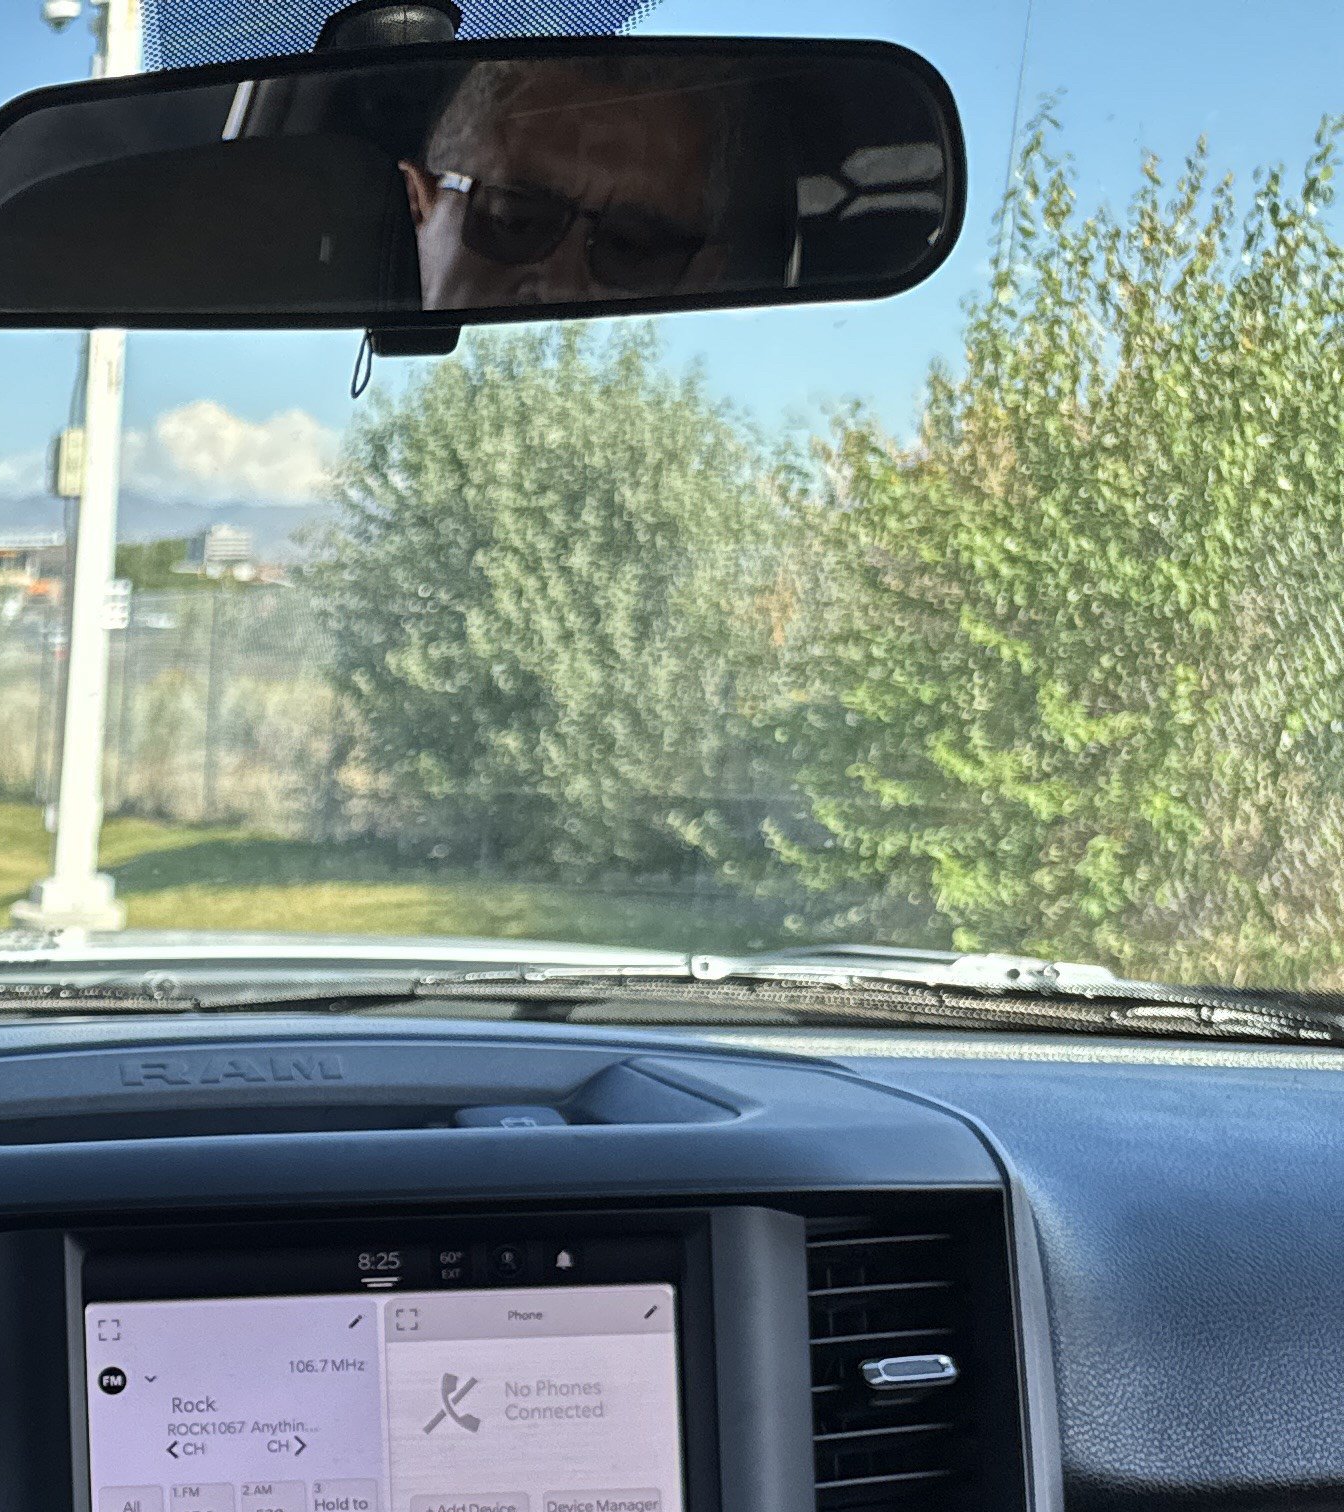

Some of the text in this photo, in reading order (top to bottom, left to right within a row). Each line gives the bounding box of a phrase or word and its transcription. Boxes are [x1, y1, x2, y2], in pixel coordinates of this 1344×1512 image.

[119, 1053, 343, 1087] RAM
[357, 1251, 400, 1270] 8:25
[508, 1310, 542, 1321] Phone
[288, 1359, 365, 1373] 106.7 MHz
[102, 1375, 123, 1387] FM
[505, 1380, 601, 1397] No Phones
[172, 1396, 216, 1413] Rock
[505, 1402, 603, 1421] Connected
[167, 1421, 245, 1436] ROCK1067
[183, 1443, 205, 1455] CH
[267, 1440, 289, 1453] CH
[173, 1487, 199, 1498] 1.FM
[242, 1485, 272, 1496] 2.AM
[123, 1501, 140, 1512] All
[314, 1498, 369, 1511] Hold to
